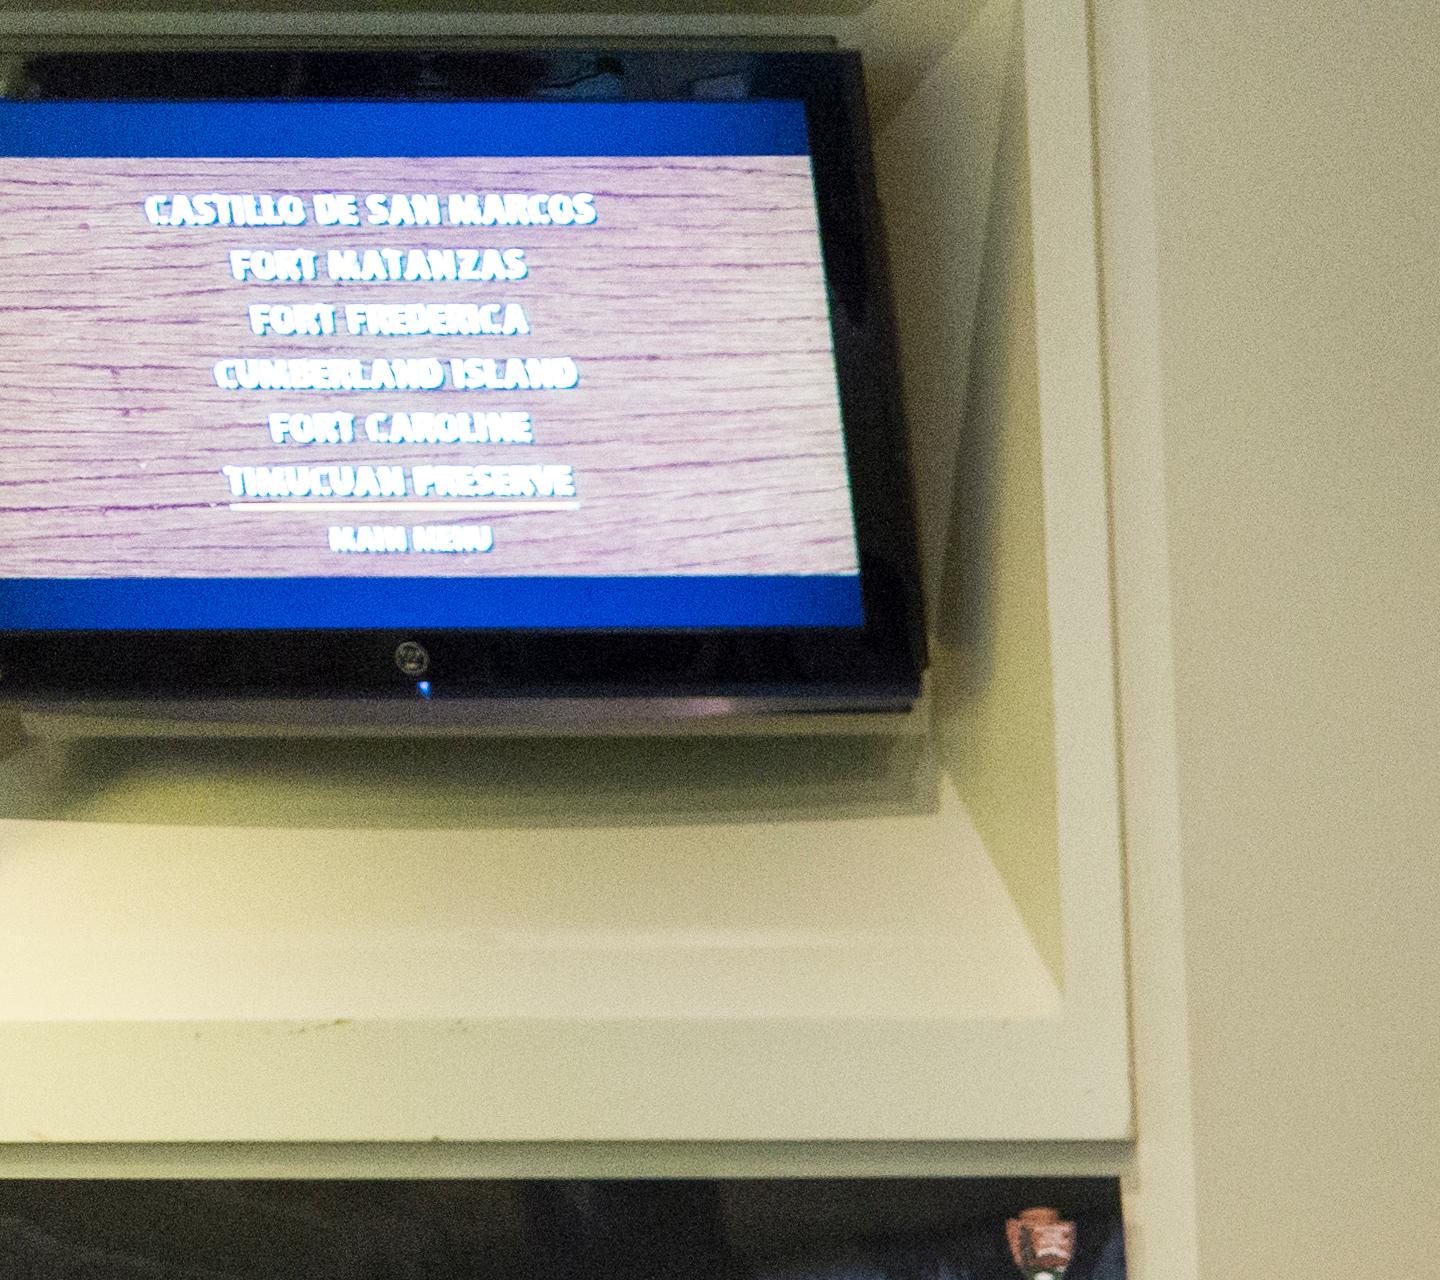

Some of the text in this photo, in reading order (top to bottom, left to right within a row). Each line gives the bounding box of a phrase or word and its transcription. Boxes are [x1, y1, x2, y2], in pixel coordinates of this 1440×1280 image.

[144, 192, 598, 226] CASTILLO DE SAN MARCOS
[229, 248, 528, 281] FORT MATANZAS
[248, 303, 530, 335] FORT FREDERICA
[213, 357, 579, 390] CUMBERLAND ISLAND
[267, 411, 534, 444] FORT CAROLINE
[222, 465, 576, 497] TIMUCUAN PRESERVE
[328, 525, 494, 553] MAIN MENU
